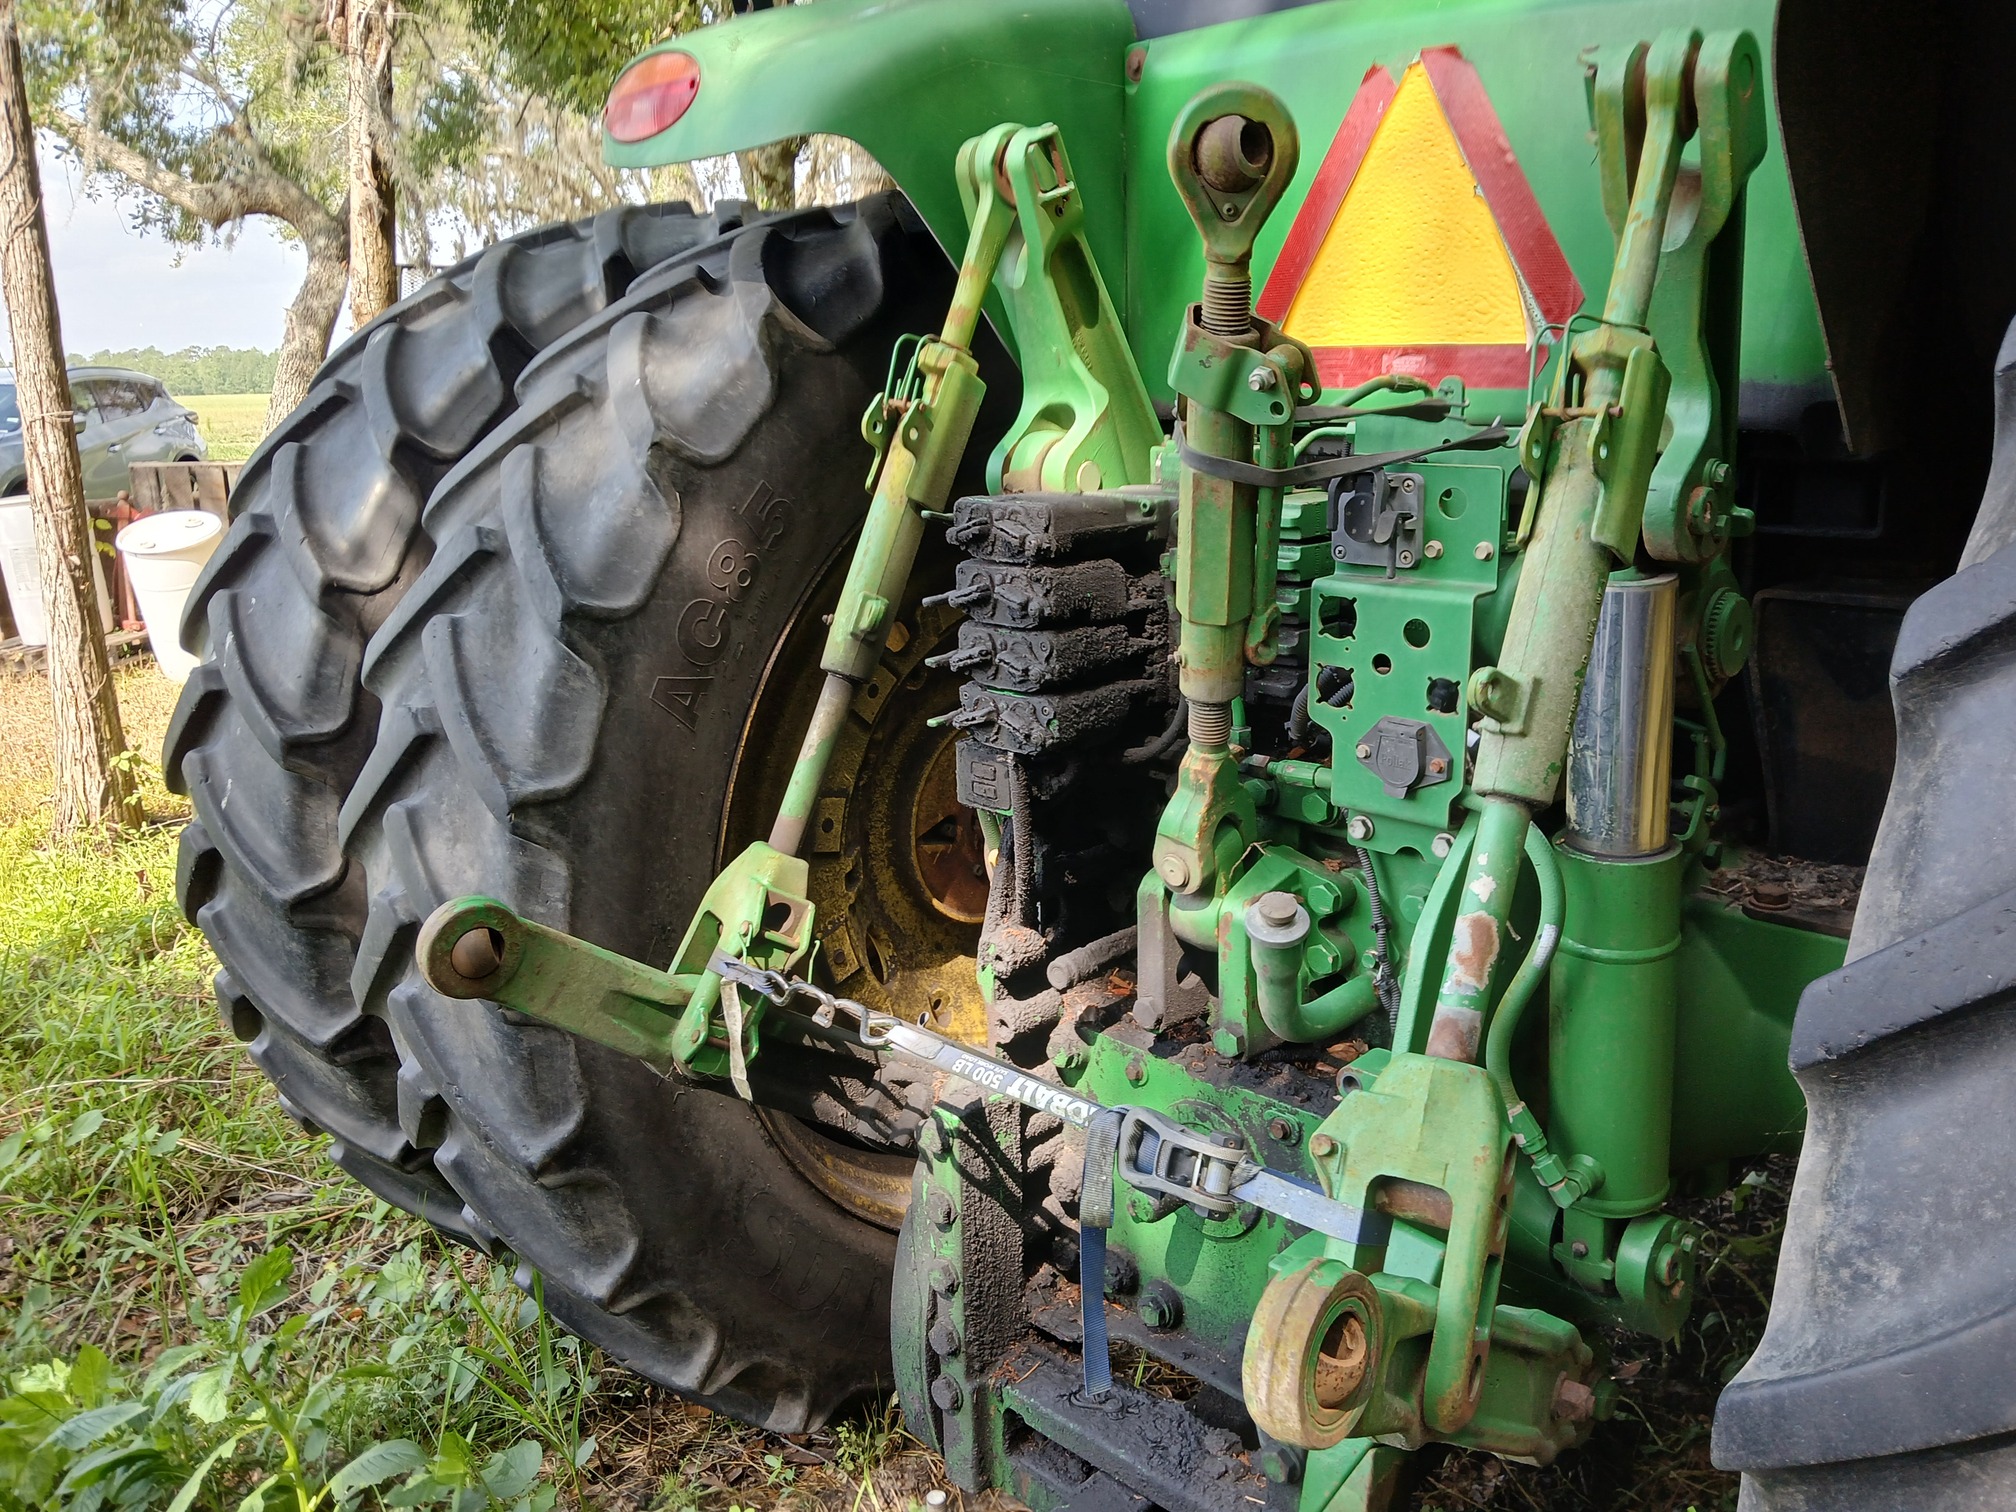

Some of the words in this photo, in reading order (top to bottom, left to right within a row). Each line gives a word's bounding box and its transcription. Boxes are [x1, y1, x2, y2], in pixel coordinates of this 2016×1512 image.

[649, 479, 796, 733] AC85
[1381, 753, 1413, 769] Pollak
[952, 1057, 973, 1074] LB
[971, 1063, 1004, 1090] 500
